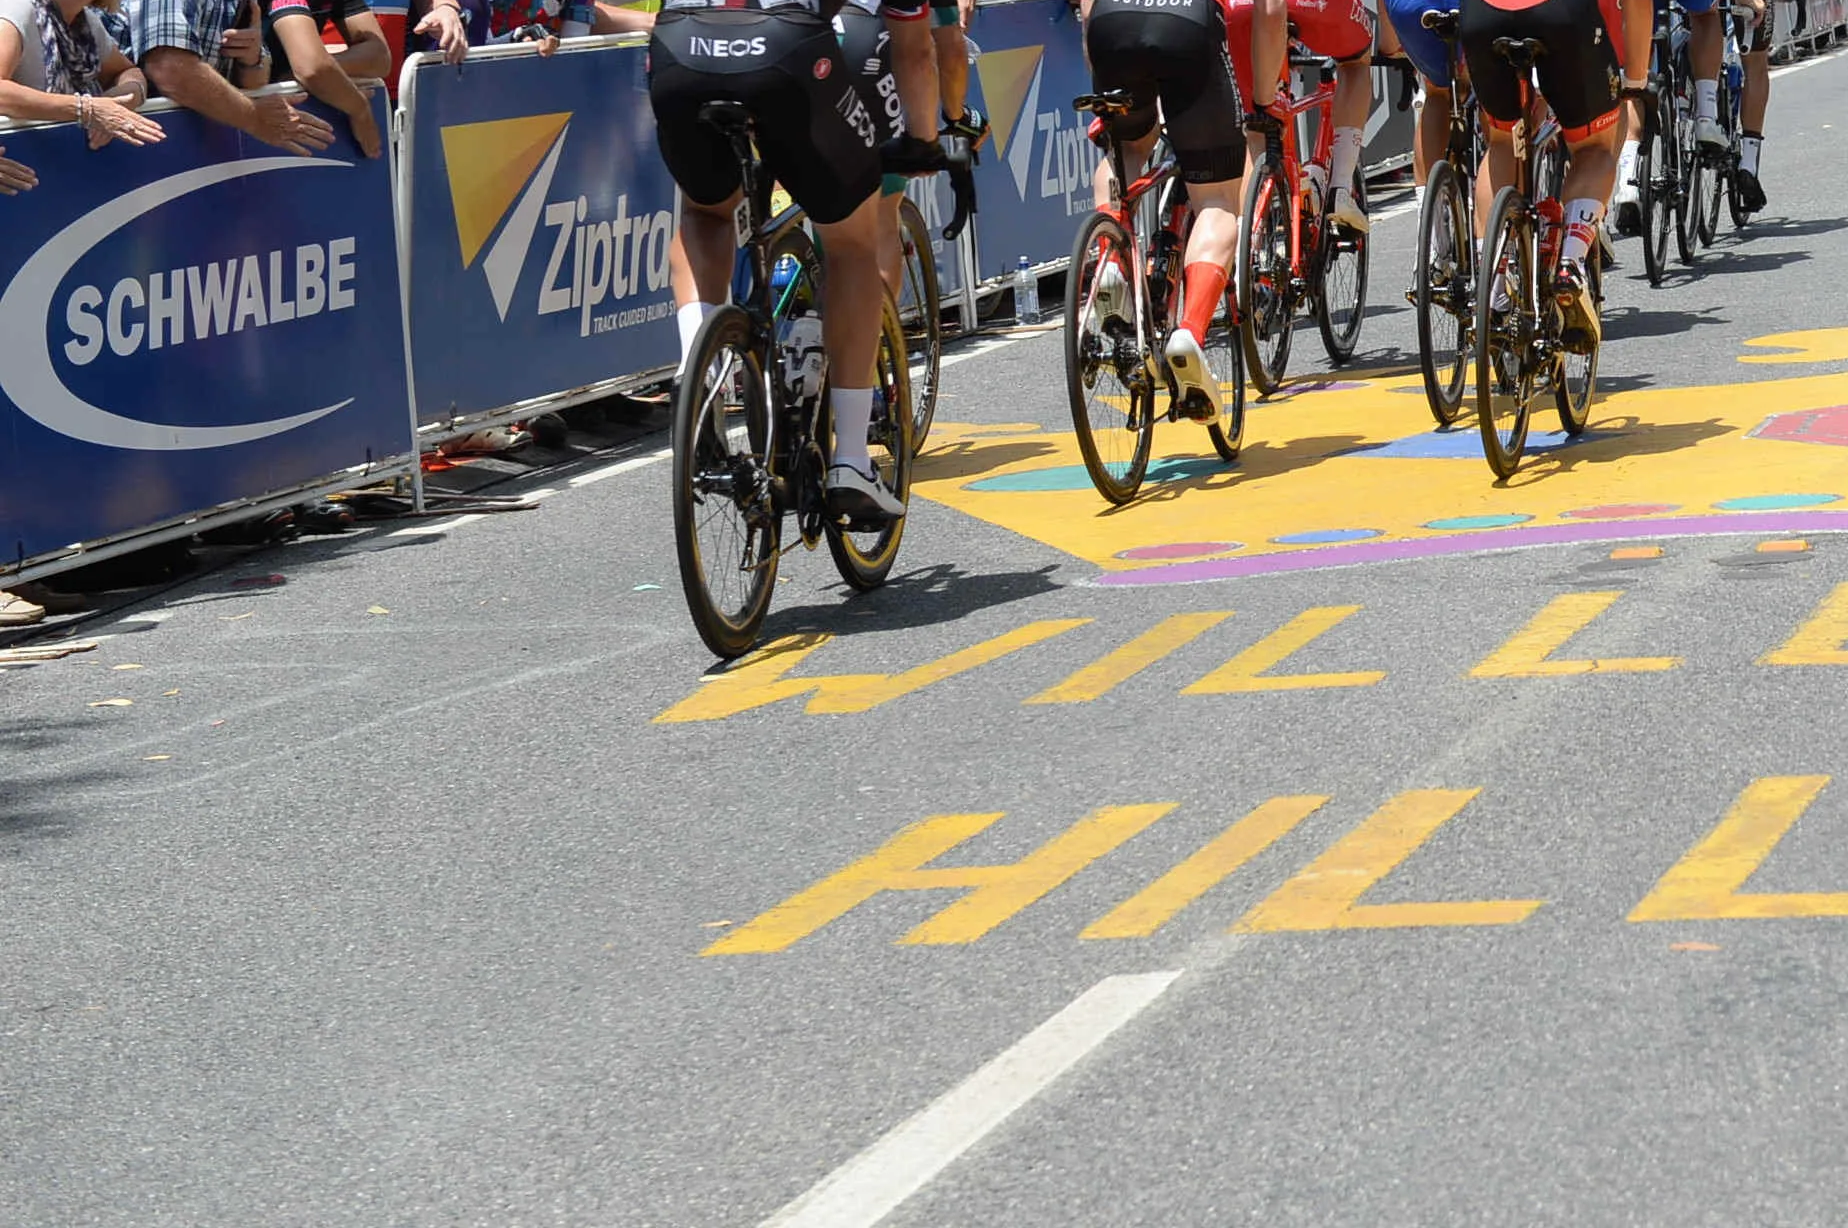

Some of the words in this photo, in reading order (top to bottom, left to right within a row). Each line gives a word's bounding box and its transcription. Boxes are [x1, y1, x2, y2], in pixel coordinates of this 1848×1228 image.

[690, 36, 767, 57] INEOS
[835, 85, 876, 148] INEOS
[63, 236, 356, 367] SCHWALBE
[593, 317, 618, 335] TRACK
